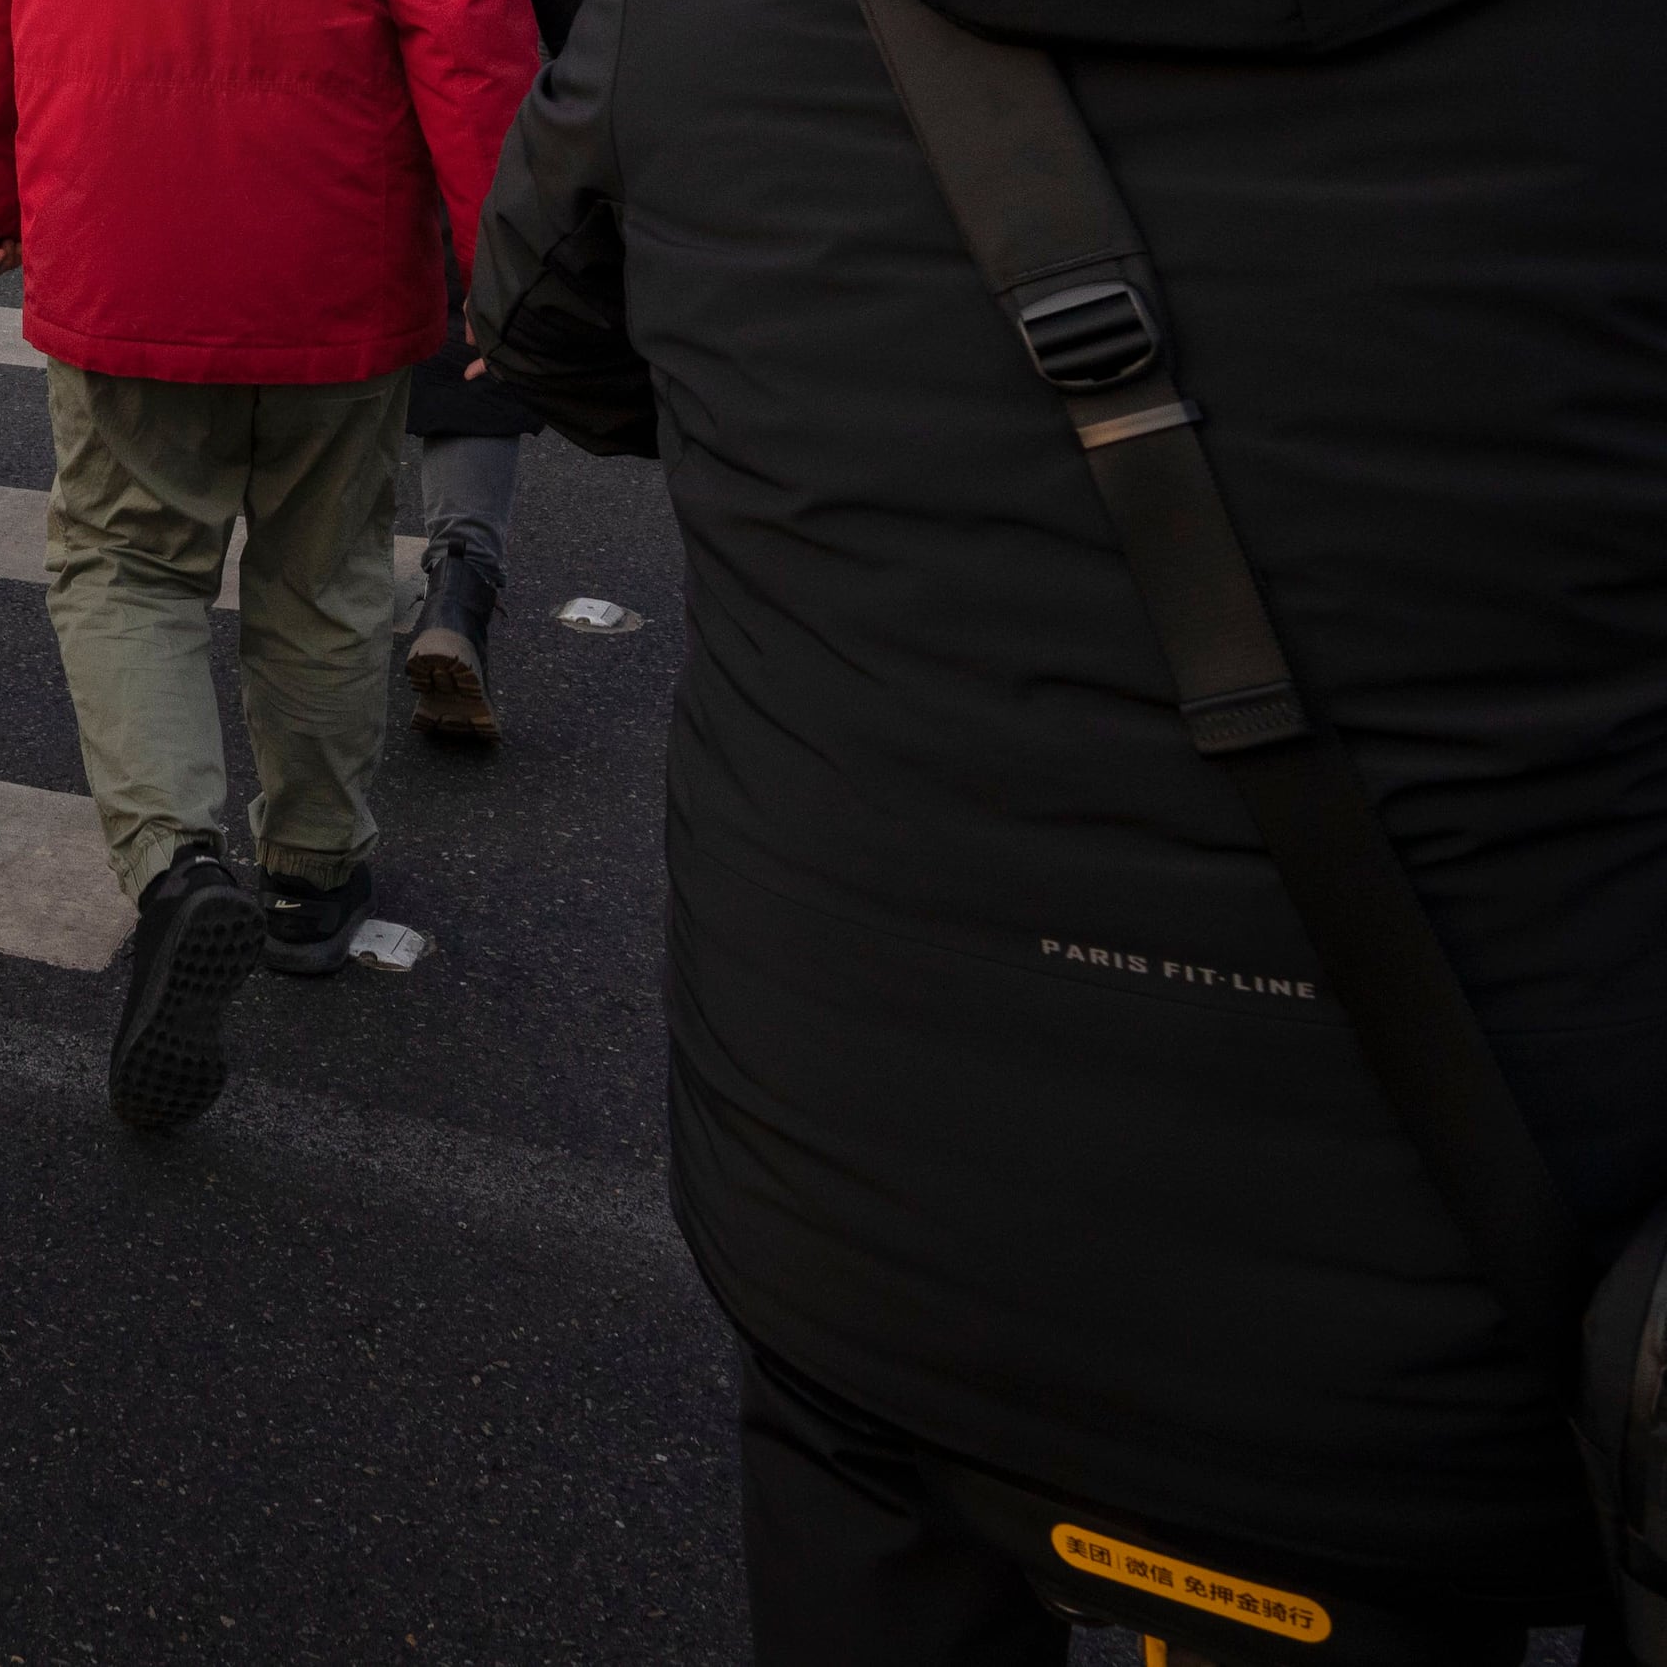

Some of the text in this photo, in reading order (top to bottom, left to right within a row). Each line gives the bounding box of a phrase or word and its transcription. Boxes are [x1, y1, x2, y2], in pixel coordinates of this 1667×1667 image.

[1040, 938, 1149, 974] PARIS
[1066, 1534, 1316, 1630] 美团 微信 免押金骑行
